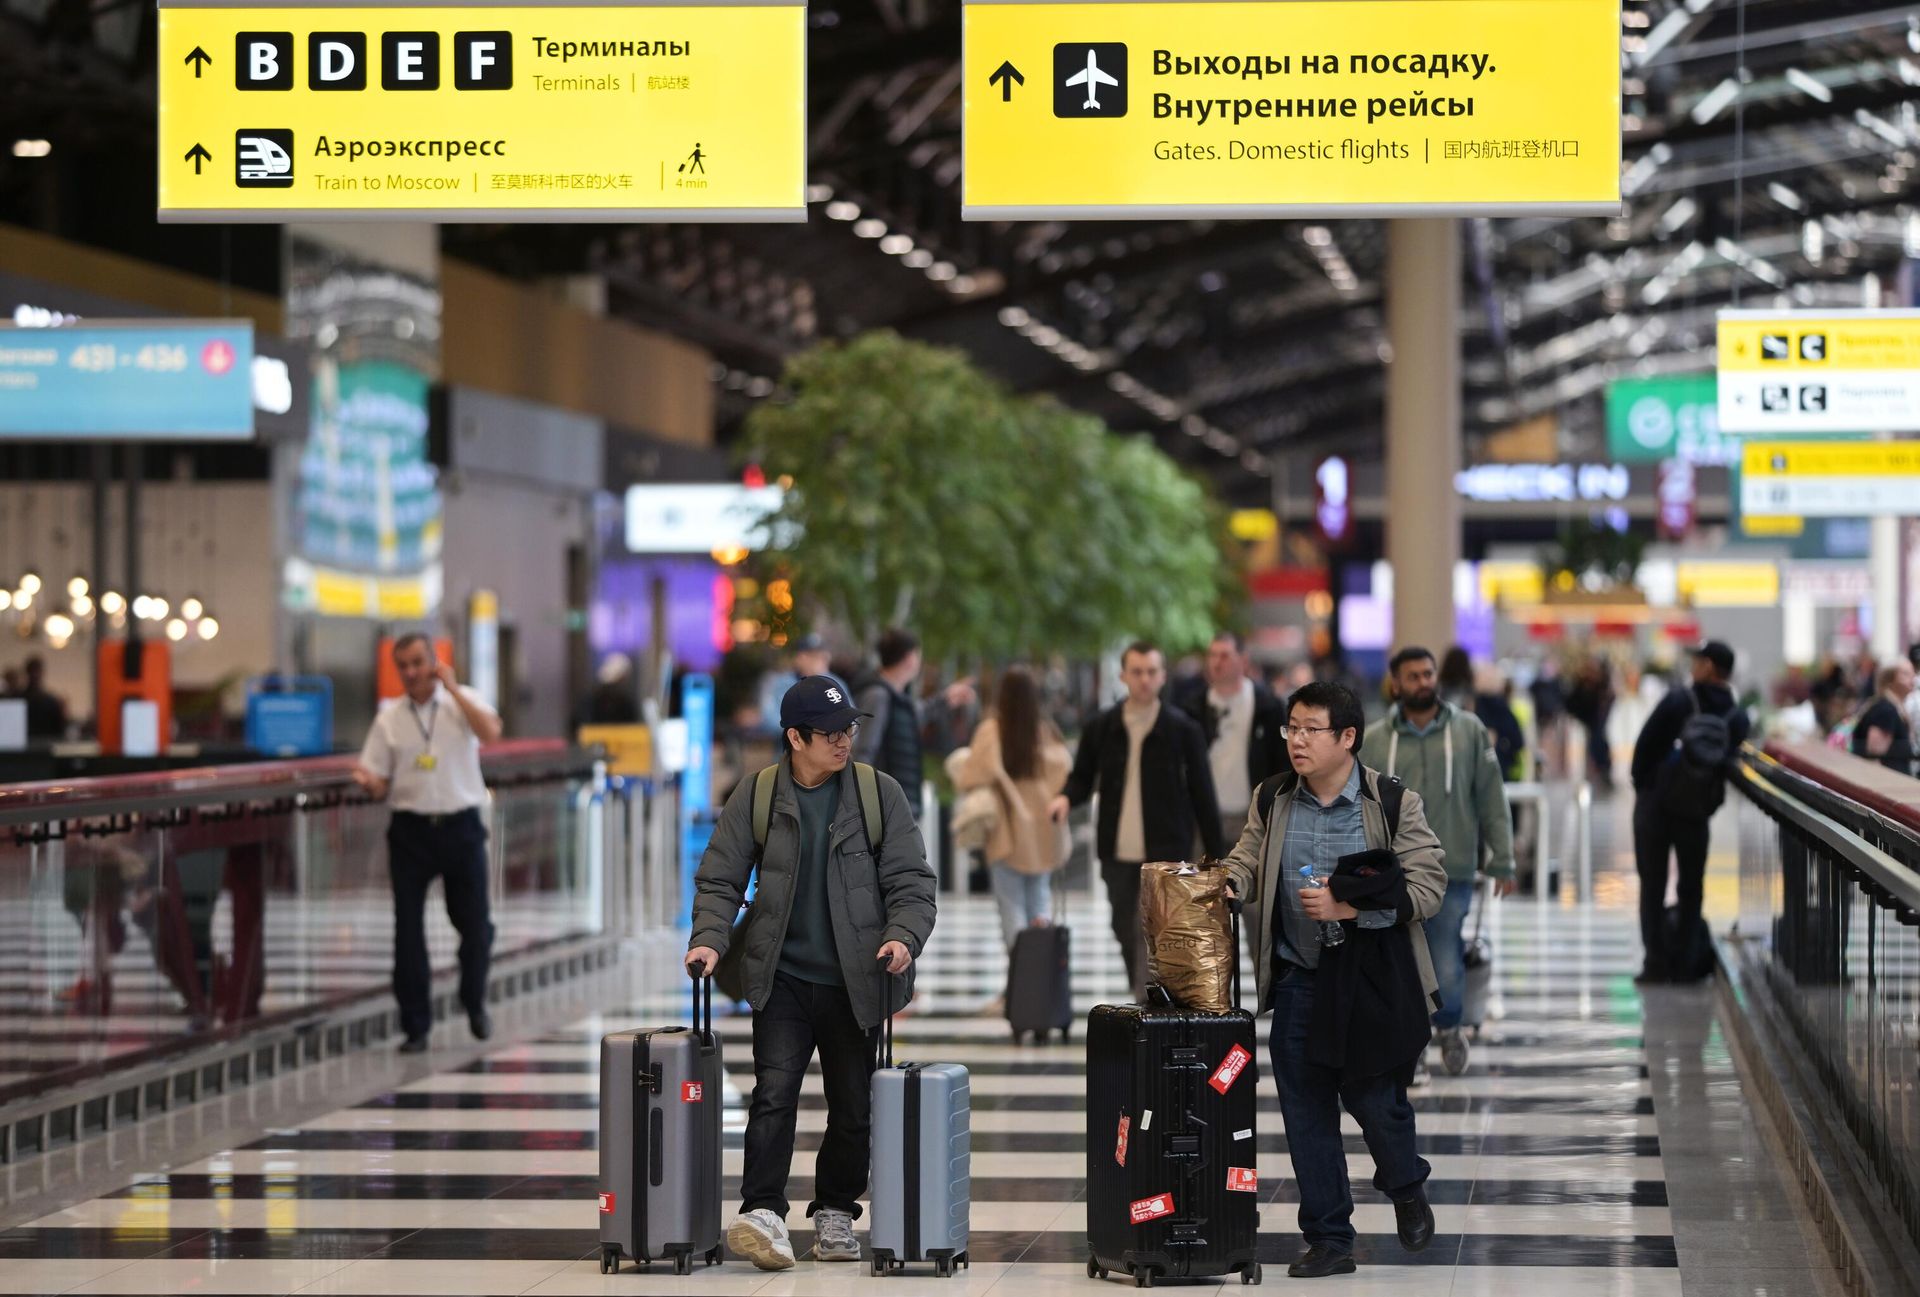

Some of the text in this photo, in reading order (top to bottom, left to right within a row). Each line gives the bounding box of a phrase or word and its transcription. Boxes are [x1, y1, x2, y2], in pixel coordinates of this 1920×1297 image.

[250, 42, 496, 81] B D E F
[531, 36, 691, 63] Терминалы
[1152, 49, 1497, 81] Выходы на посадку.
[531, 73, 621, 92] Terminals
[647, 75, 691, 90] 航站楼
[1152, 89, 1474, 126] Внутренние рейсы
[313, 135, 507, 162] Аэроэкспресс
[1153, 137, 1410, 165] Gates. Domestic flights
[1443, 138, 1580, 160] 国内航班登机口
[313, 174, 461, 192] Train to Moscow
[490, 173, 634, 190] 至莫斯科市区的火车
[675, 178, 708, 189] 4 min
